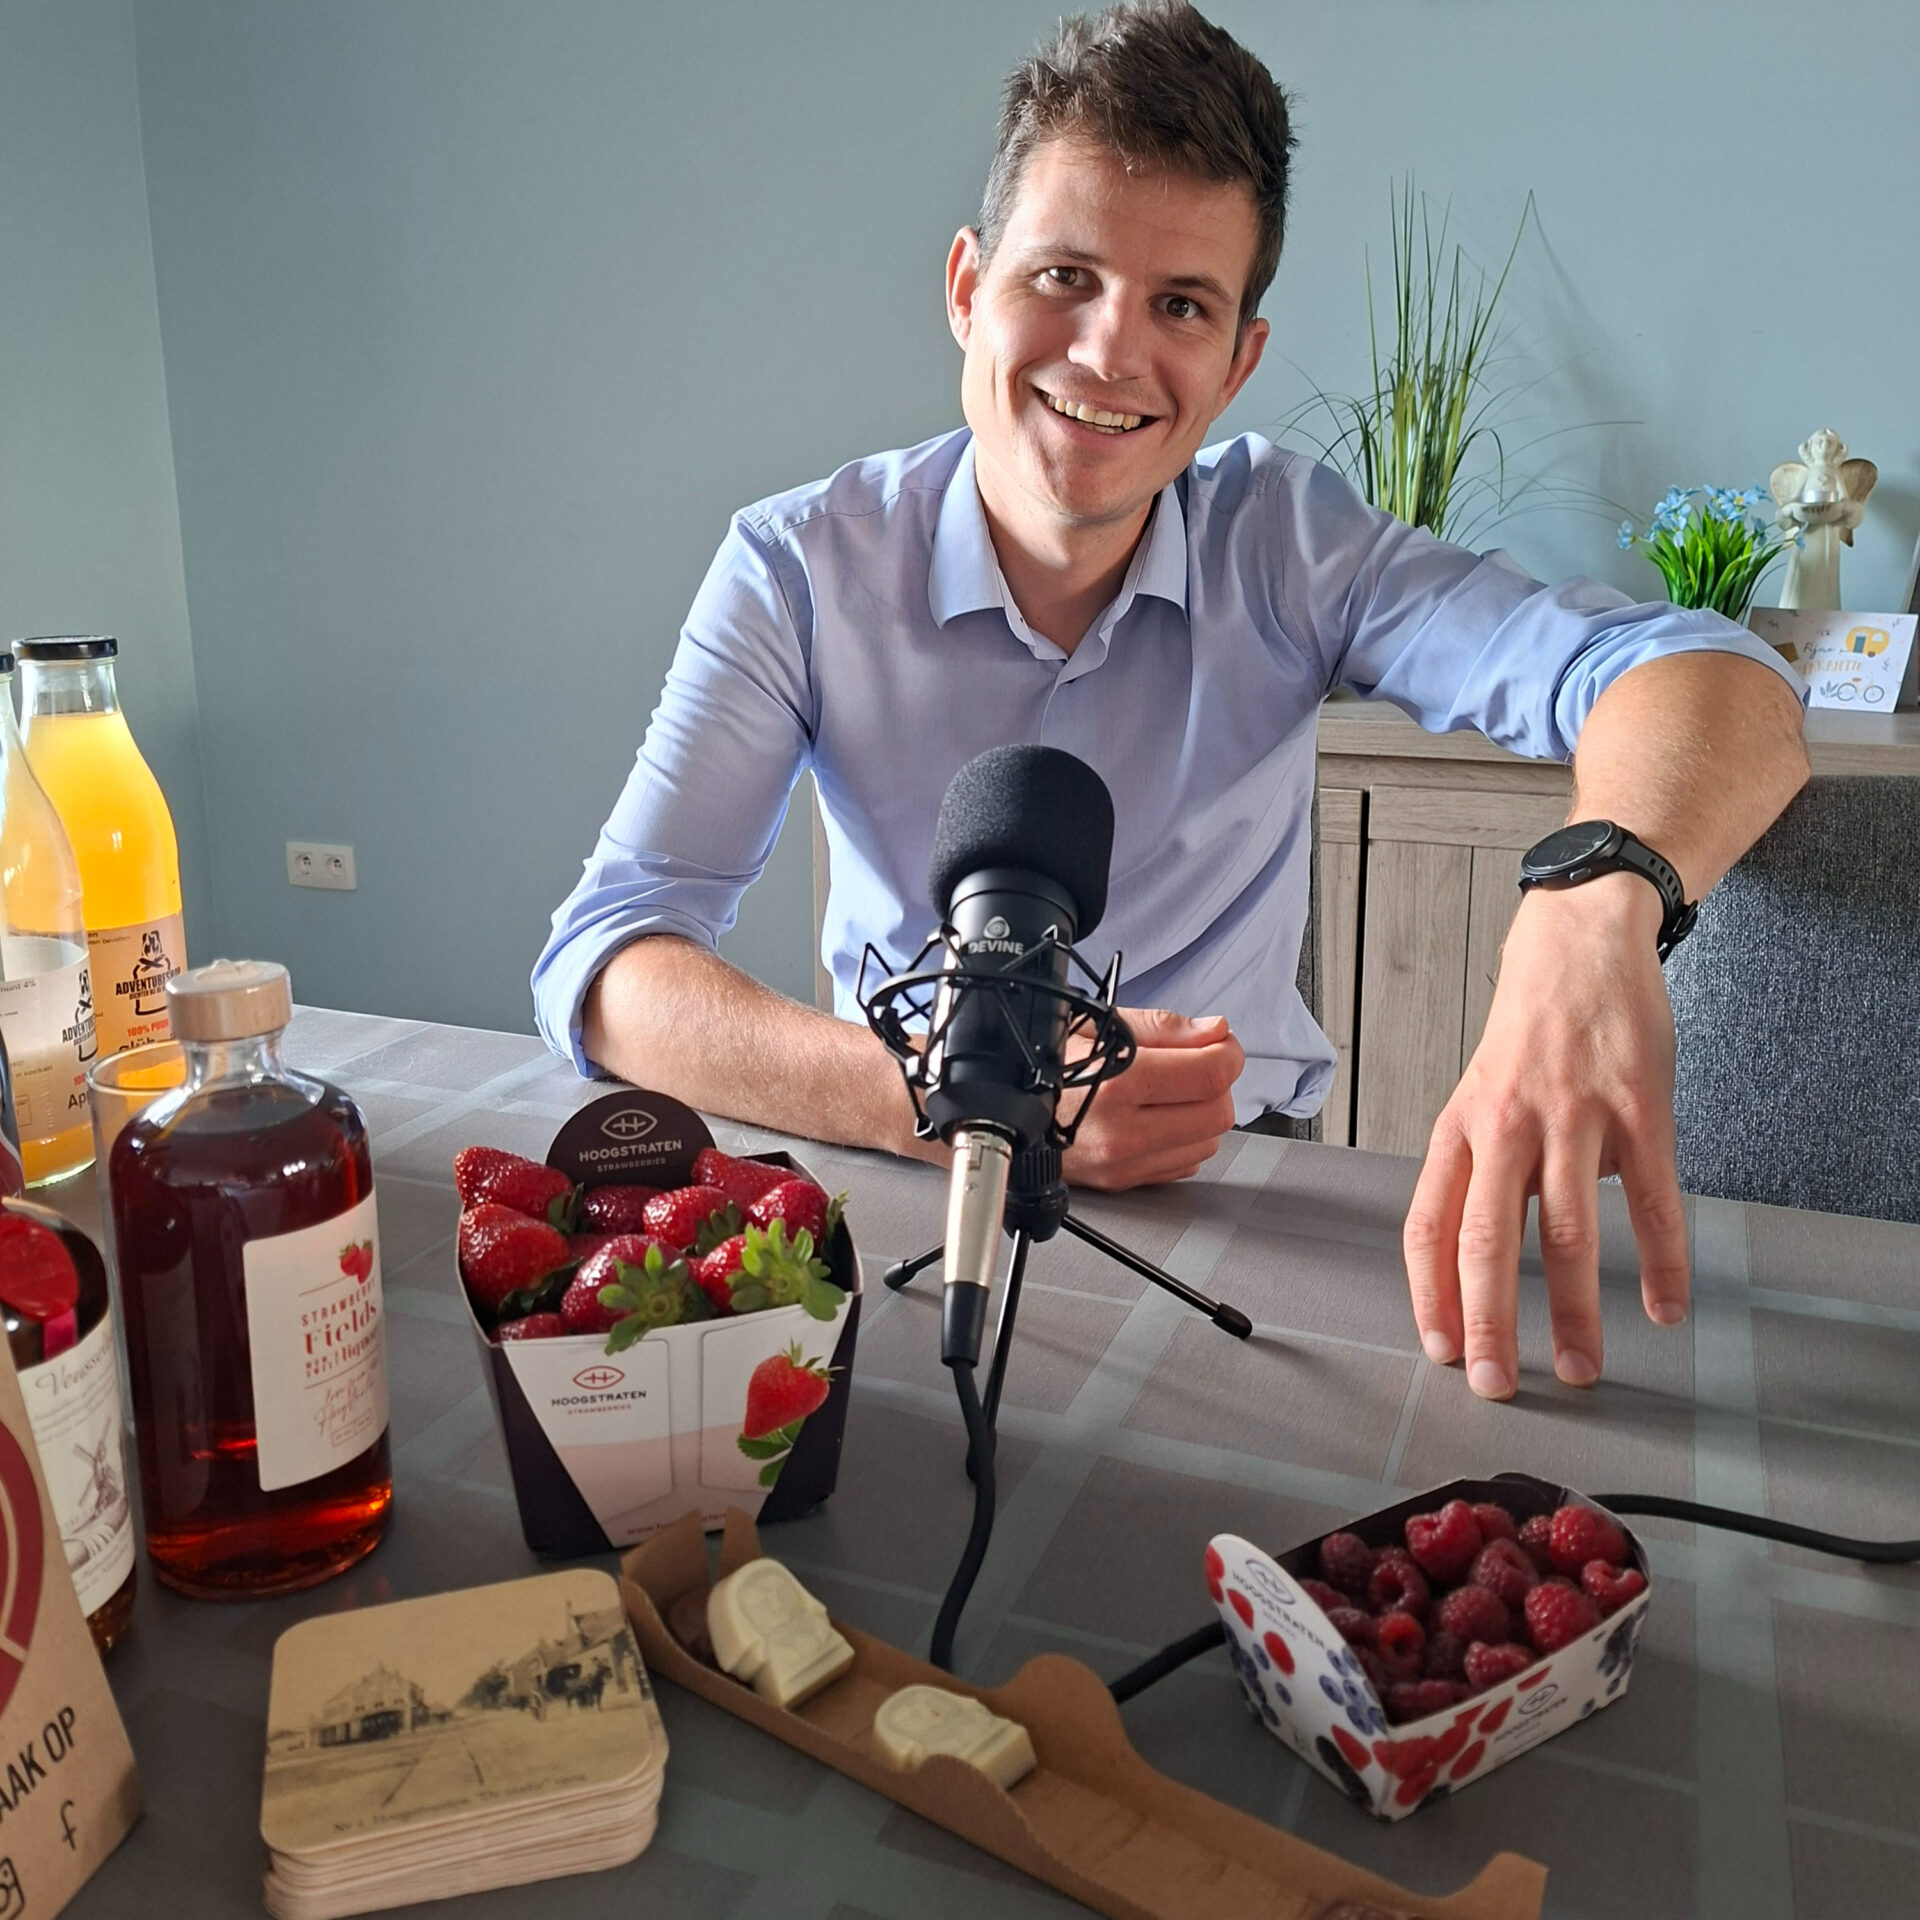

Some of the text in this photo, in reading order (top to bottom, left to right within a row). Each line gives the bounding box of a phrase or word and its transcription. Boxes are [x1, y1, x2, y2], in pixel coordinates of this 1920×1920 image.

[968, 940, 1024, 955] DEVINE
[126, 1023, 150, 1037] 100%
[578, 1139, 682, 1162] HOOGSTRATEN
[596, 1157, 666, 1173] STRAWBERRIES
[301, 1277, 376, 1327] STRAWBERRY
[304, 1299, 377, 1355] Fields
[551, 1390, 647, 1407] HOOGSTRATEN
[1232, 1570, 1325, 1648] HOOGSTRATEN
[43, 1706, 75, 1763] OP
